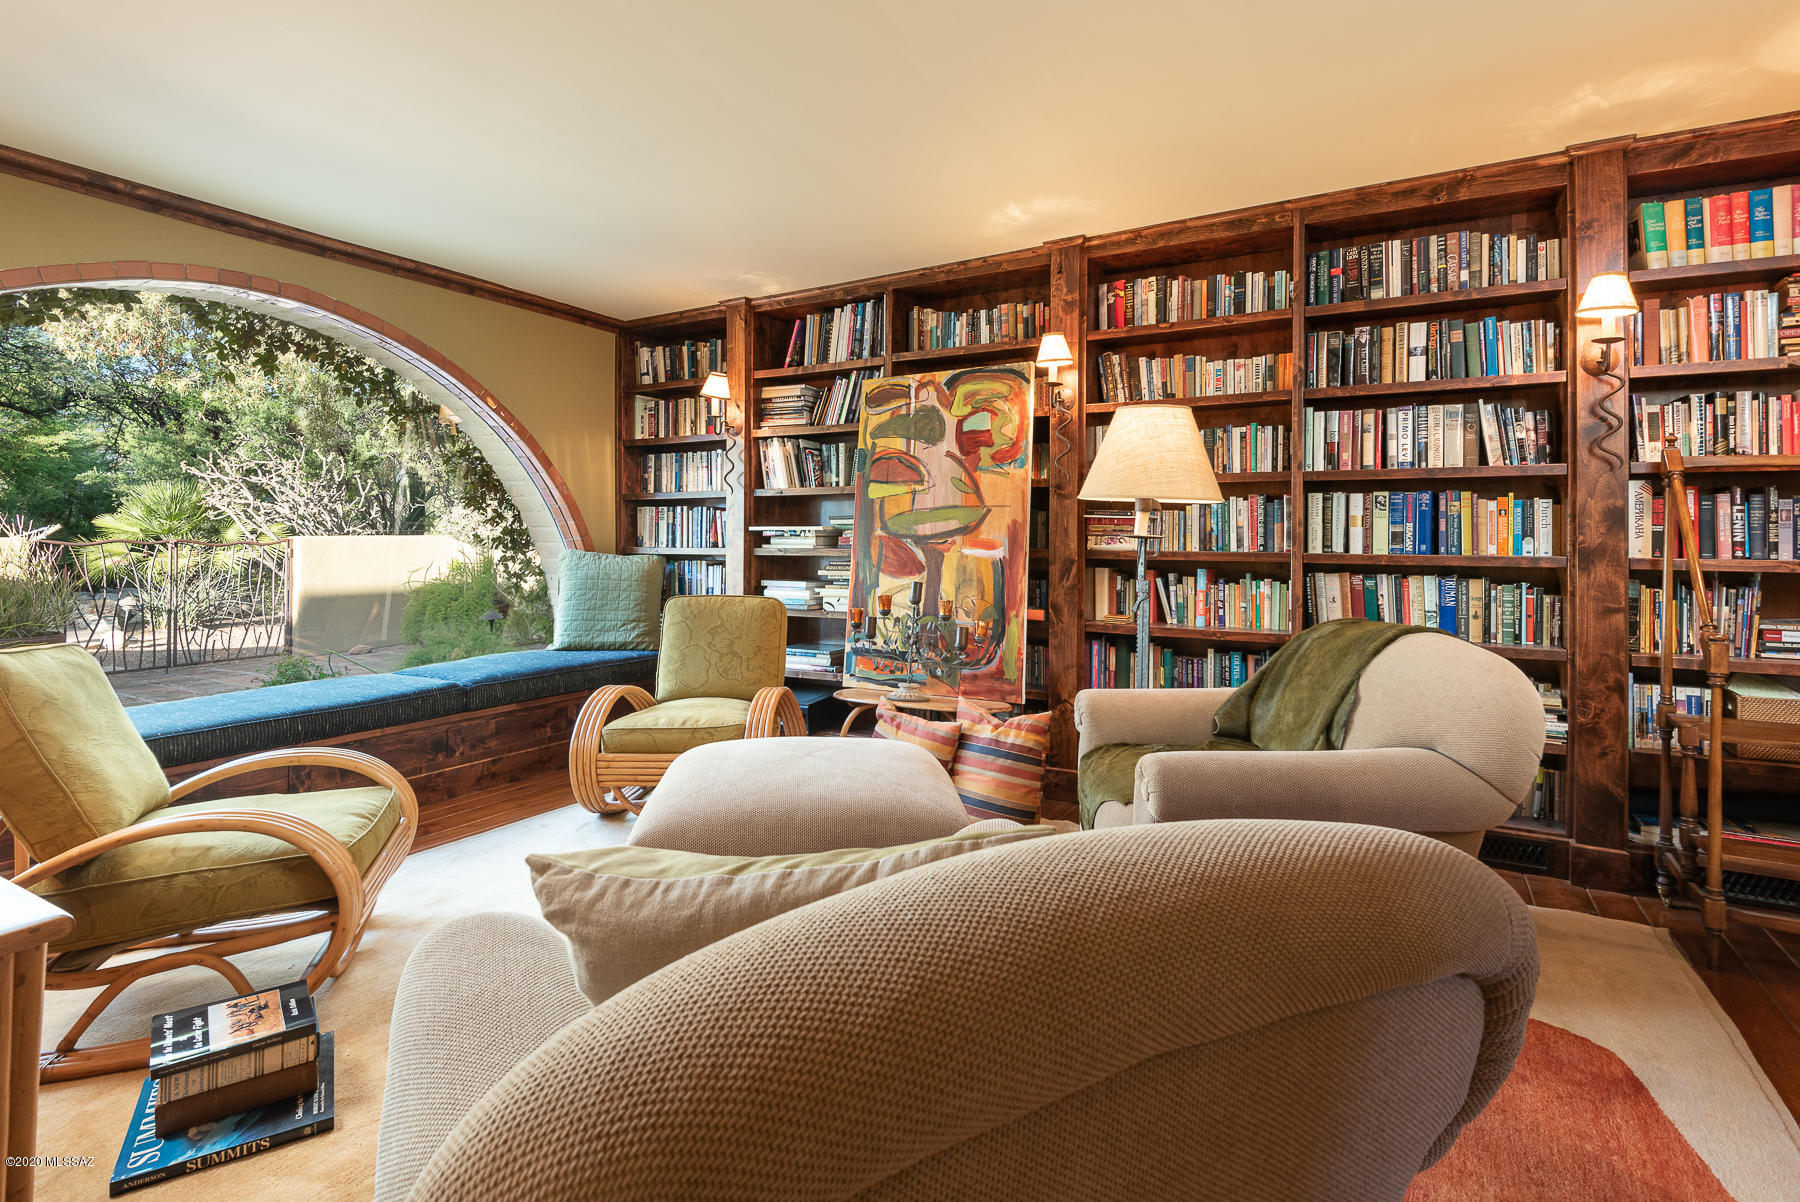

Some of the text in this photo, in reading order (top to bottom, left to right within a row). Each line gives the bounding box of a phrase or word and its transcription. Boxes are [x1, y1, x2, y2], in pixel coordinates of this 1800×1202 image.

[1447, 254, 1458, 282] CAESAR
[1401, 412, 1409, 439] PRIMO
[1541, 501, 1551, 529] Dutch
[1635, 490, 1644, 539] АМЕРИКАНА
[1732, 505, 1744, 542] LENIN
[1445, 578, 1456, 606] TRUMAN
[163, 1015, 174, 1029] Nest
[193, 1017, 204, 1029] Fight
[122, 1137, 271, 1190] ANDERSON SUMMITS
